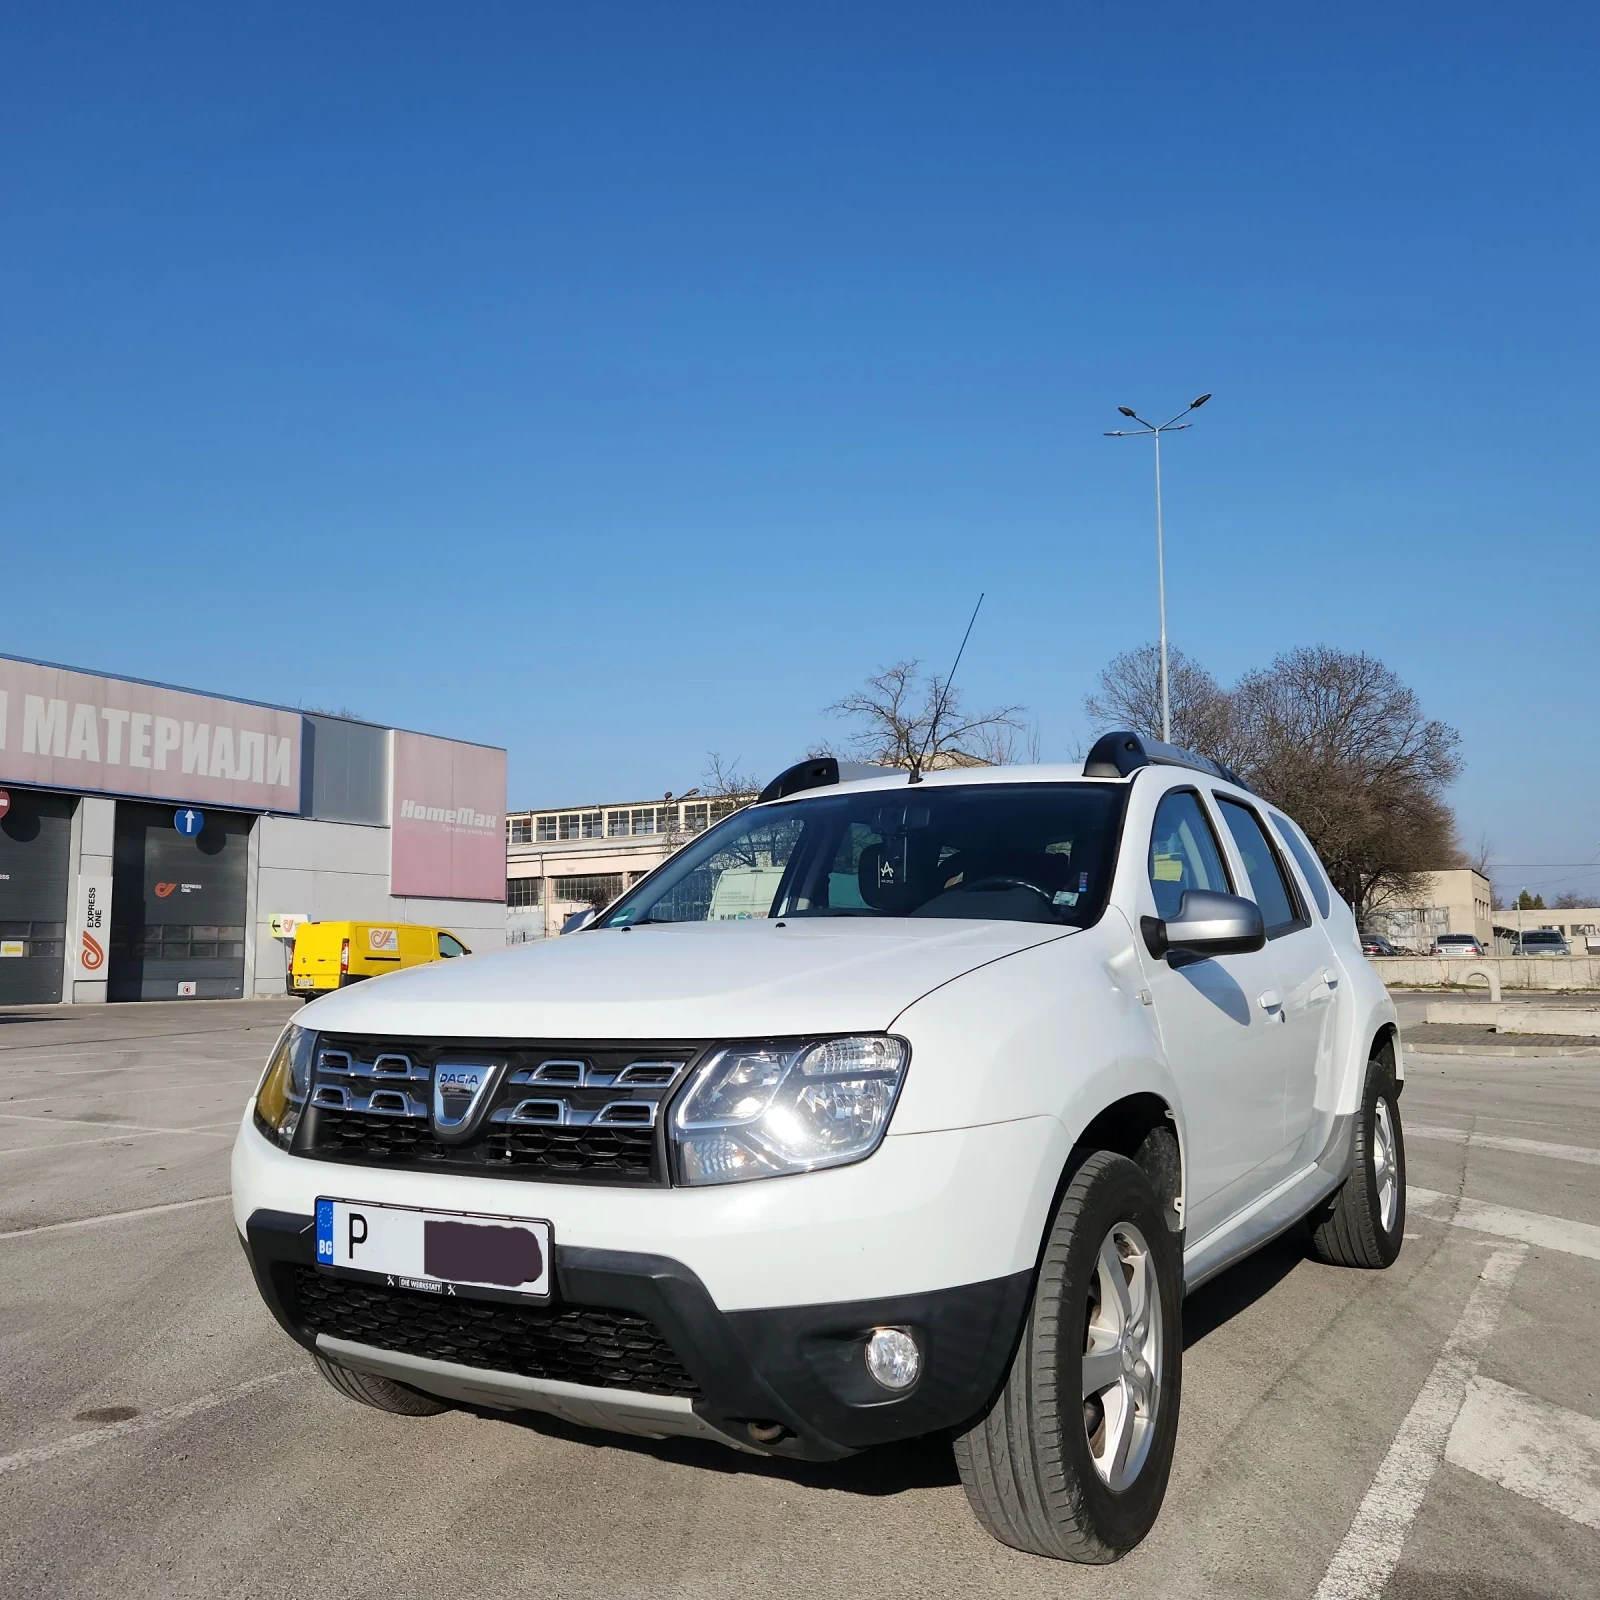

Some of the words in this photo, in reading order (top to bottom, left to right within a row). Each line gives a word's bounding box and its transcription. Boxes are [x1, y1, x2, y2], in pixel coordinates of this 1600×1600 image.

[22, 694, 291, 787] МАТЕРИАЛИ
[400, 799, 497, 828] HomeMax
[87, 887, 96, 928] EXPRESS
[94, 909, 102, 928] ONE
[439, 1073, 479, 1085] DACIA
[318, 1239, 333, 1256] BG
[348, 1212, 368, 1260] P
